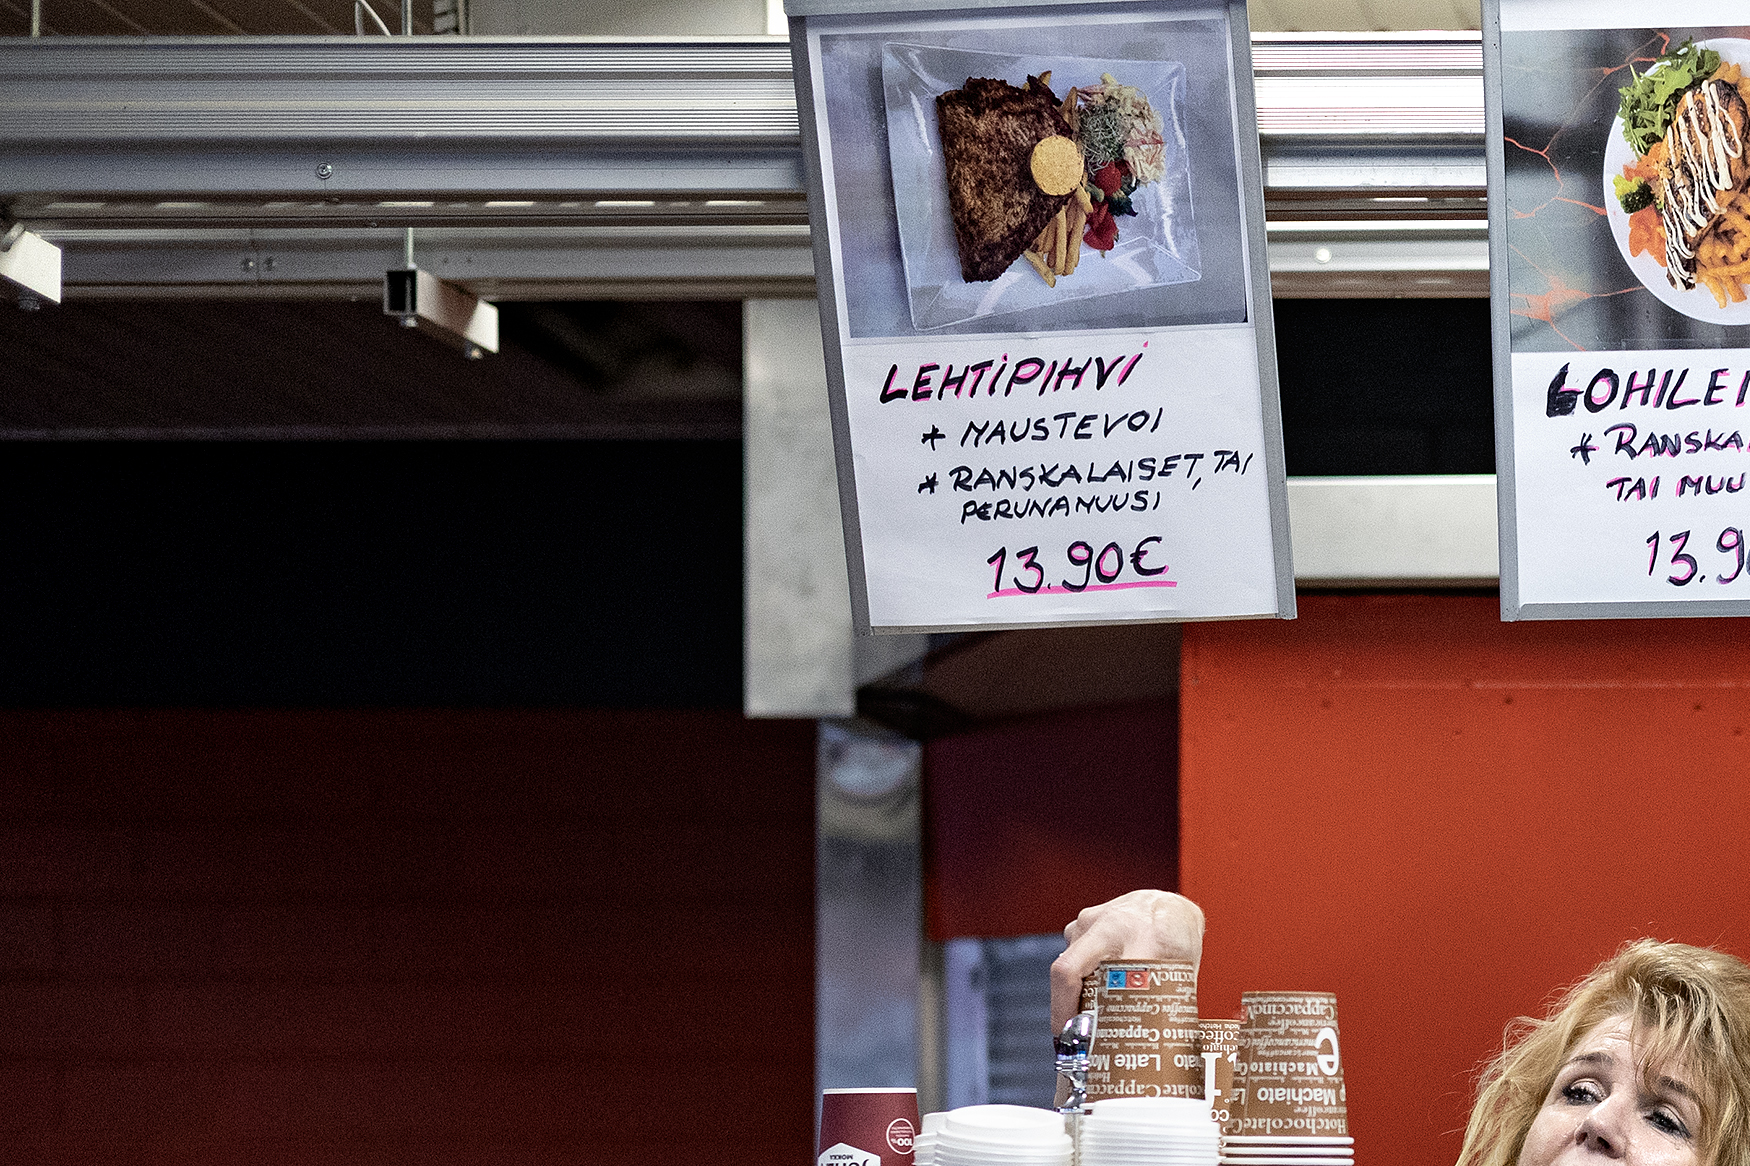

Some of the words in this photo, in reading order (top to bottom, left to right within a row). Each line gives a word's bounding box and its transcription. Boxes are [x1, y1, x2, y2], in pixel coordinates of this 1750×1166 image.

[879, 341, 1150, 404] LEHTIPIHVI
[960, 407, 1164, 449] MAUSTEVOI
[1213, 449, 1255, 476] TAI
[1606, 473, 1660, 502] TAI
[986, 535, 1171, 596] 13.90€
[1114, 1054, 1161, 1072] Latte
[1257, 1087, 1336, 1106] Machiato
[1243, 1117, 1346, 1135] Hotchocolate
